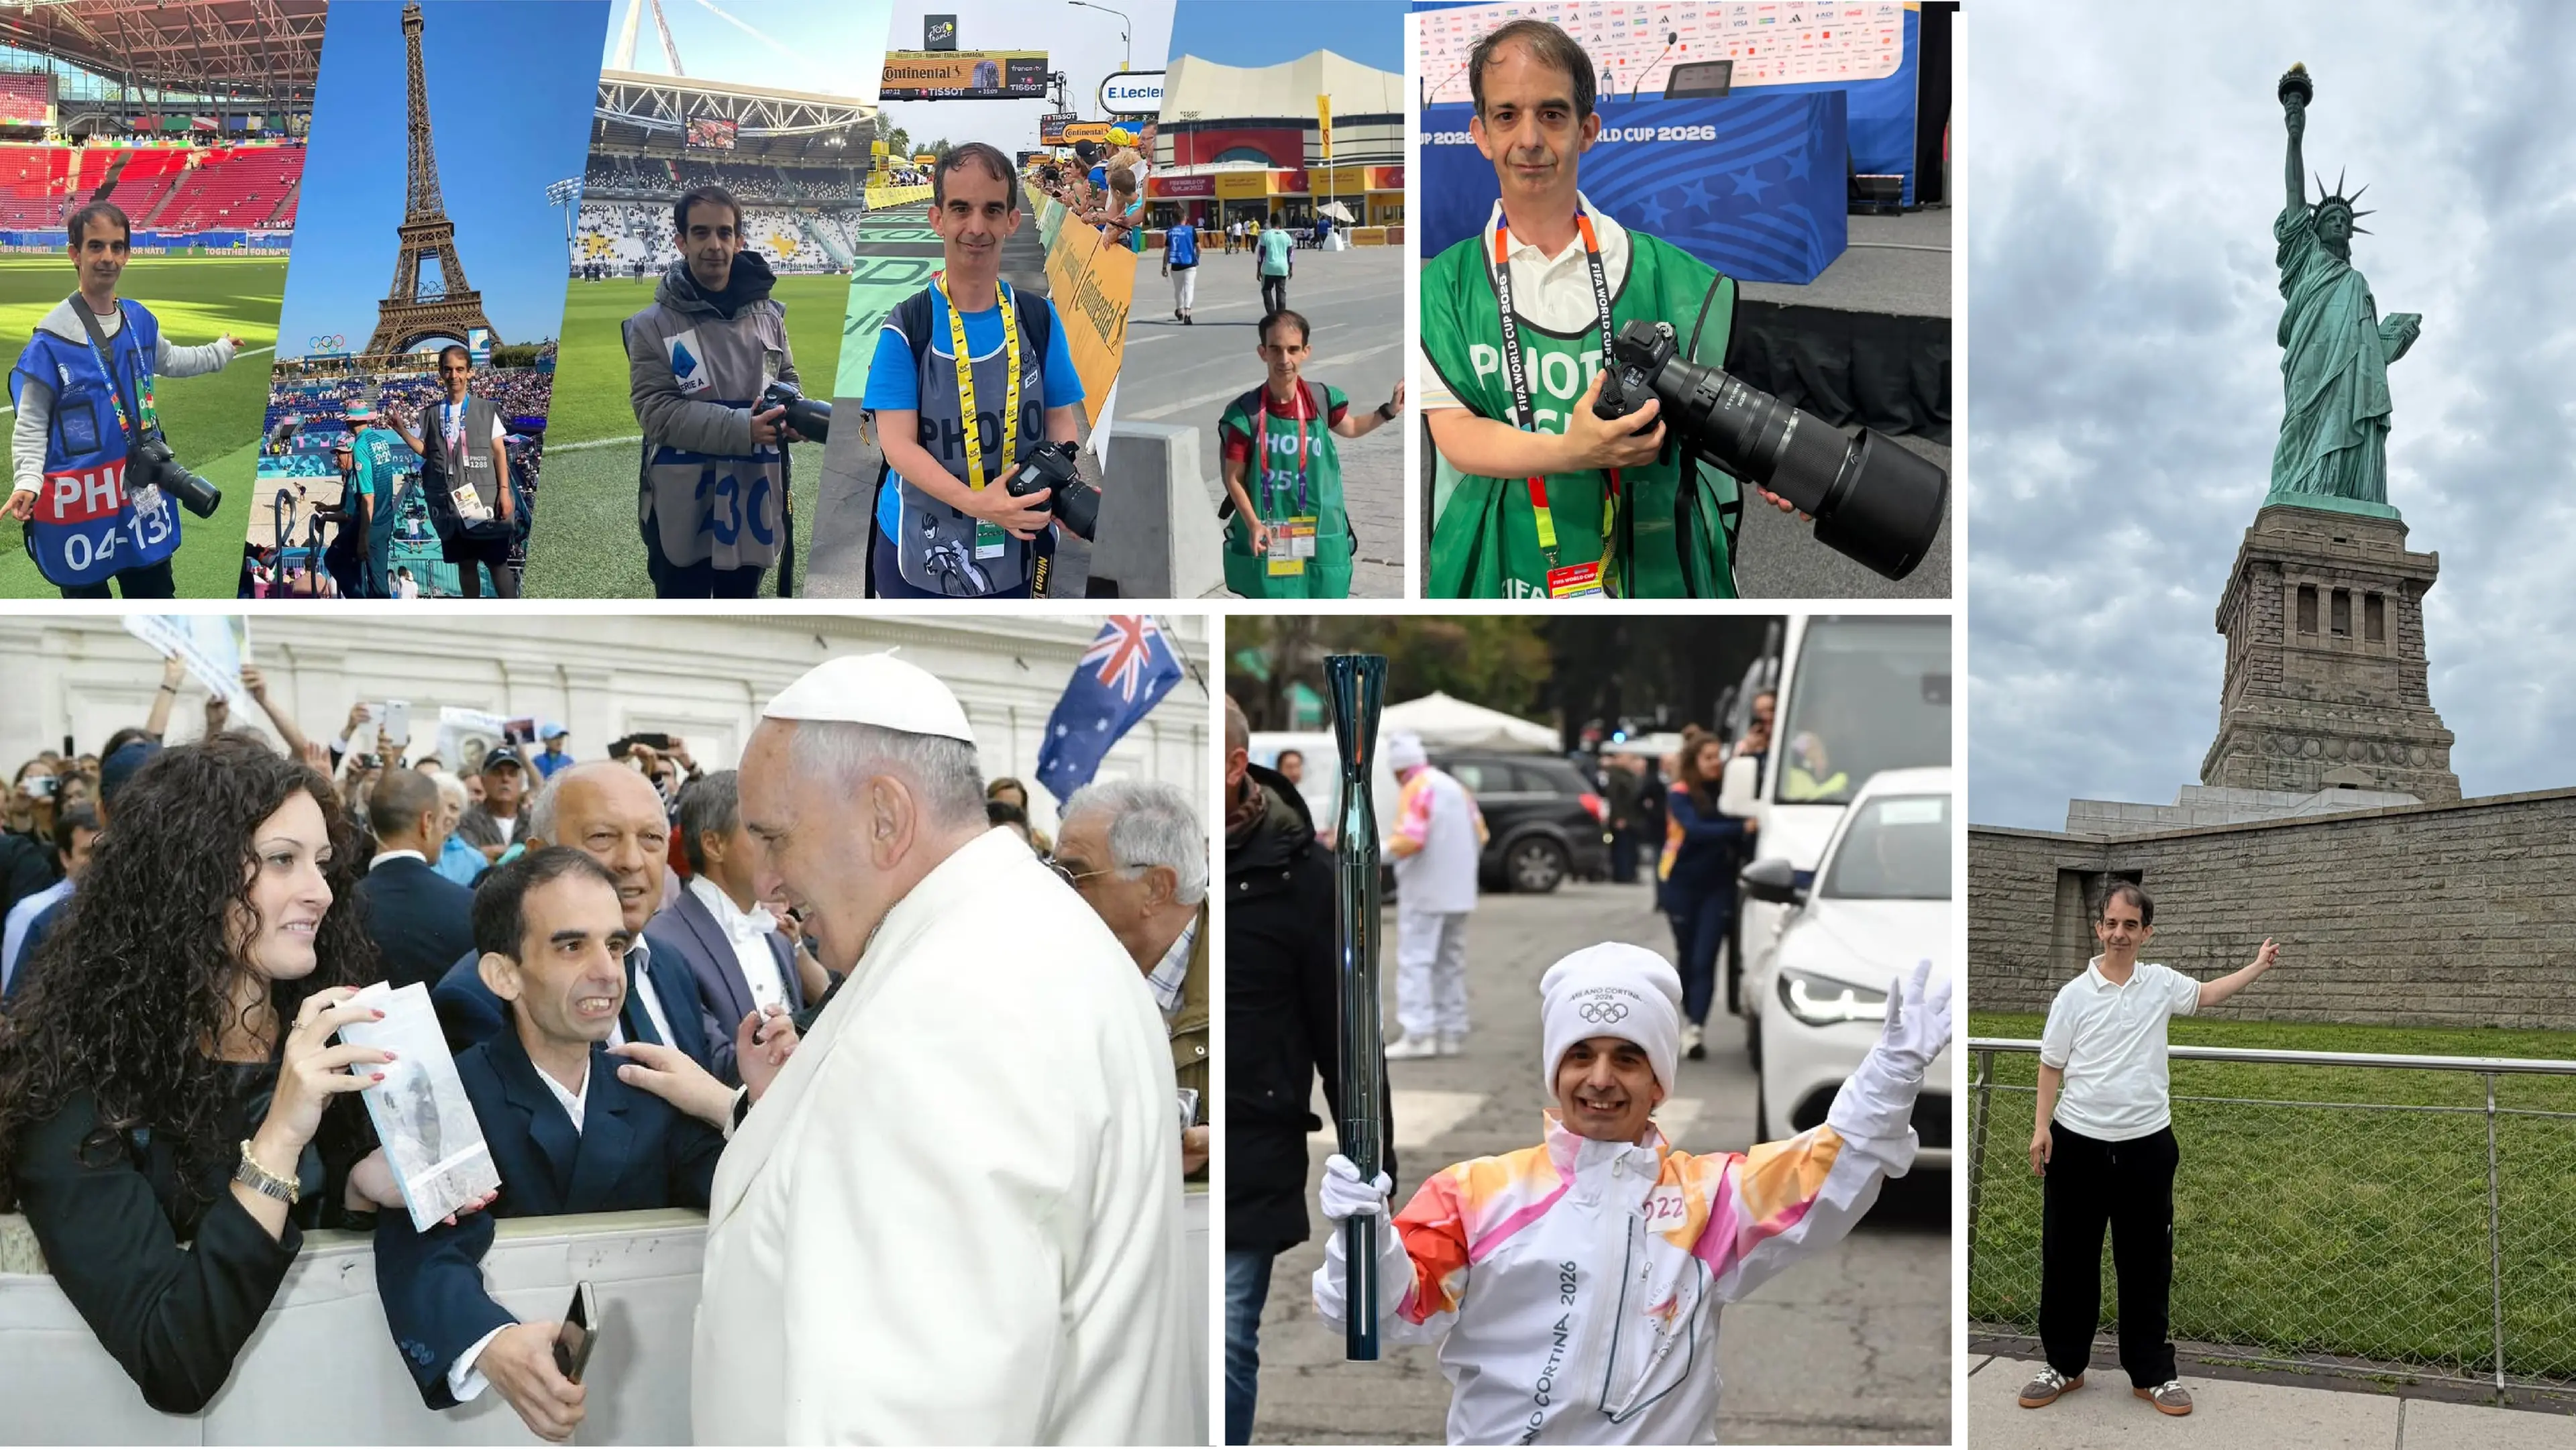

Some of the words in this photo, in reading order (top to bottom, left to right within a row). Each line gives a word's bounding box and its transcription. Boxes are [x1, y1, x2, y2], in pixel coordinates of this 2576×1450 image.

[883, 66, 951, 82] Continental
[929, 88, 965, 97] TISSOT
[1065, 127, 1104, 138] Continental
[1624, 127, 1655, 142] CUP
[1657, 125, 1716, 142] 2026
[204, 247, 248, 256] TOGETHER
[250, 248, 268, 256] FOR
[1590, 262, 1603, 287] FIFA
[1499, 274, 1511, 315] 2026
[1075, 269, 1123, 345] Continental
[1596, 287, 1610, 328] WORLD
[1503, 316, 1515, 339] CUP
[1602, 331, 1612, 356] CUP
[1507, 340, 1523, 384] WORLD
[678, 380, 697, 392] ERIE
[698, 378, 705, 386] A
[1516, 384, 1529, 412] FIFA
[470, 461, 488, 469] 1288
[1035, 555, 1048, 591] Nikon
[1568, 987, 1603, 1002] MILANO
[1605, 987, 1646, 1003] CORTINA
[1534, 1312, 1570, 1408] CORTINA
[1560, 1260, 1577, 1306] 2026
